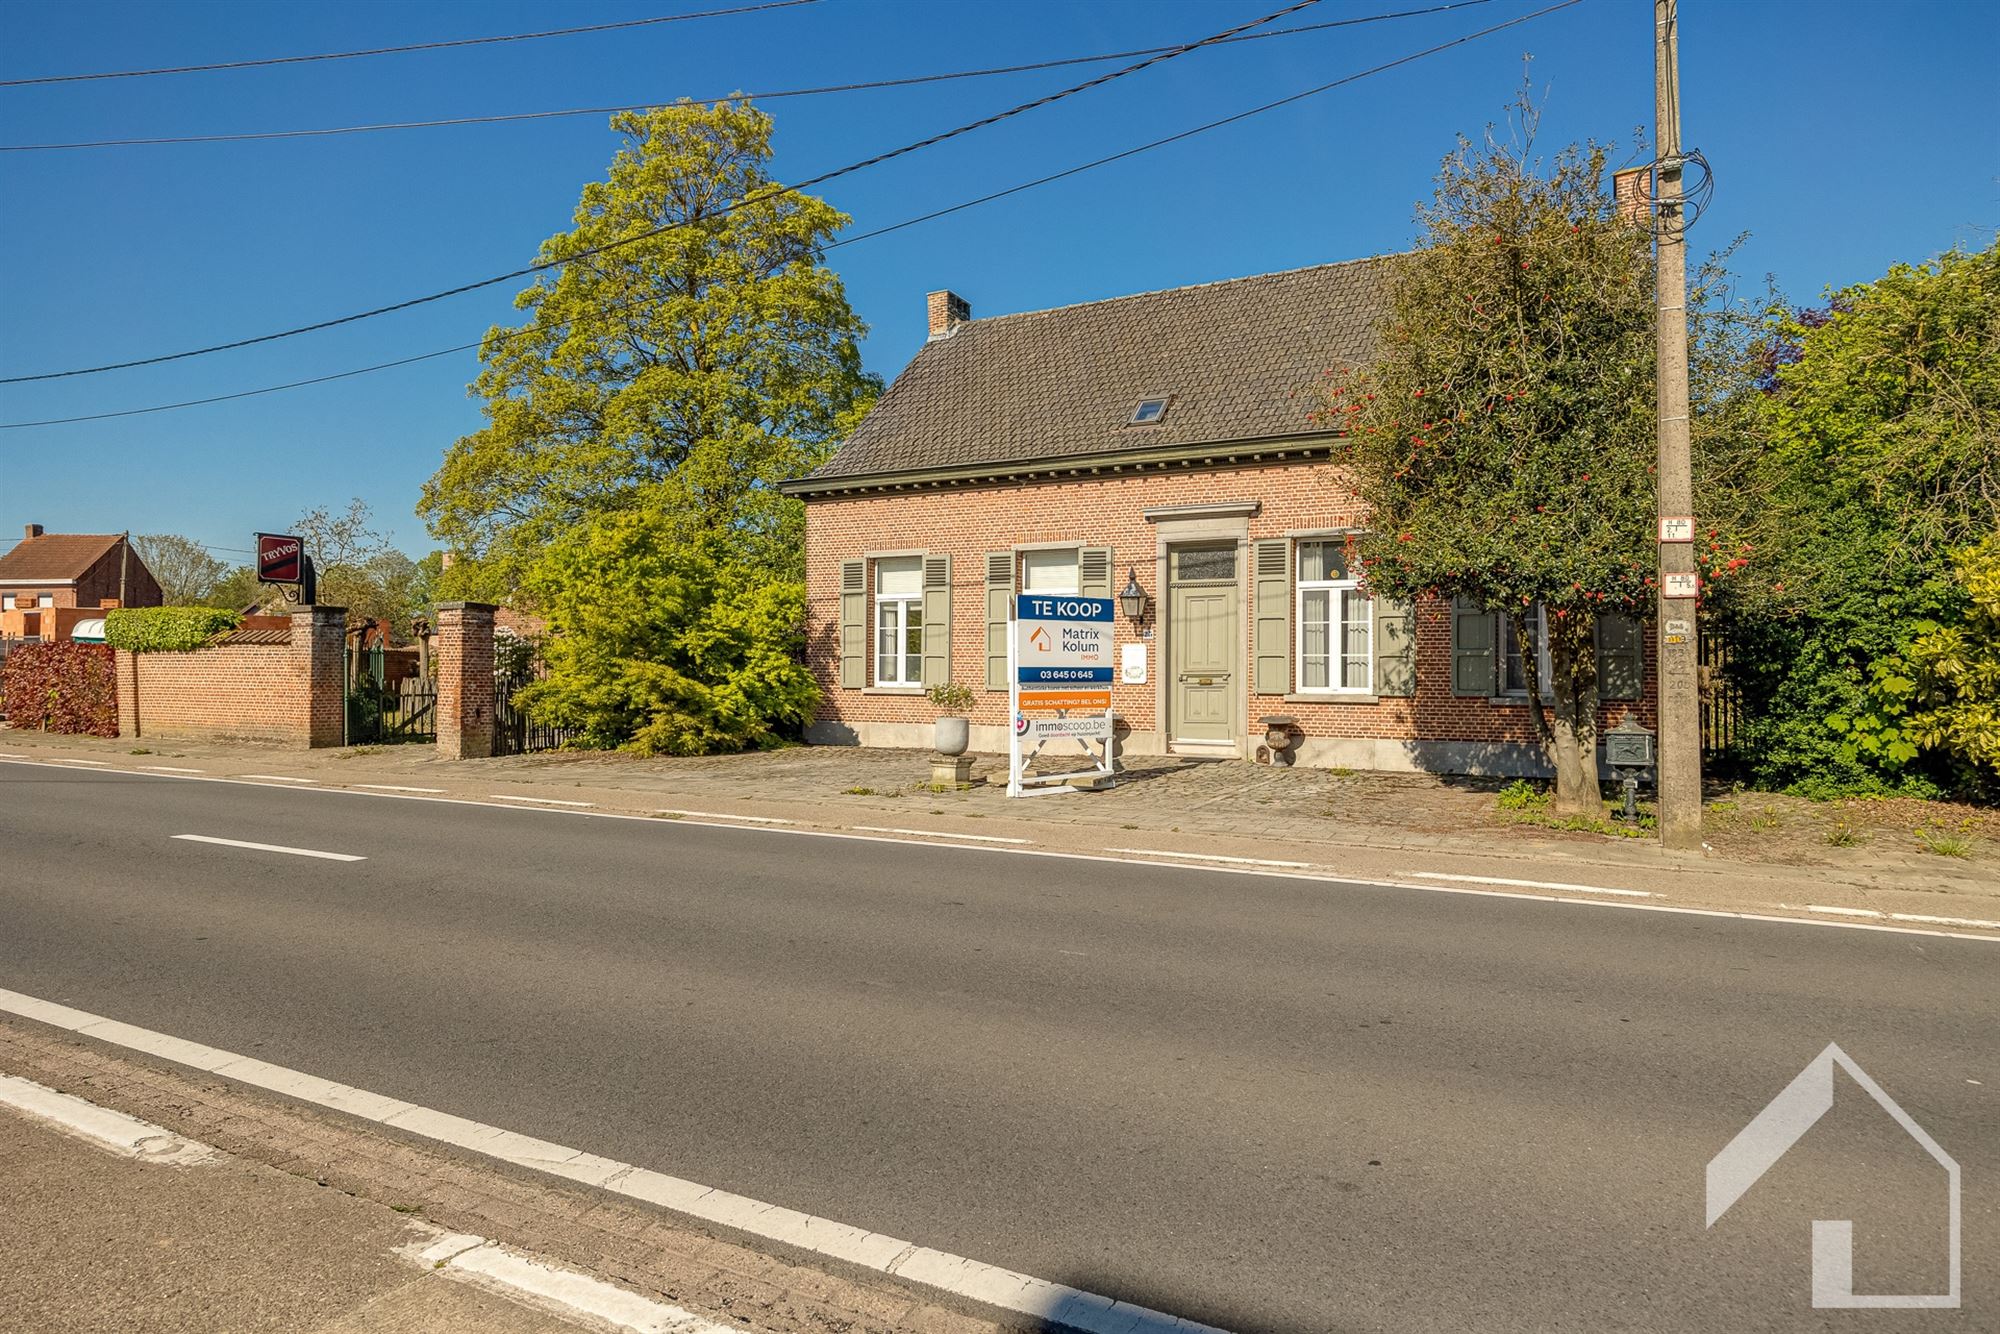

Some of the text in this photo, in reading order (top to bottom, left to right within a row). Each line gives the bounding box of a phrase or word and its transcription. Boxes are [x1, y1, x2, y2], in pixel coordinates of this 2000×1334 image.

[261, 543, 298, 561] TRYVOS
[1032, 600, 1102, 617] TE KOOP
[1062, 628, 1099, 640] Matrix
[1062, 640, 1099, 652] Kolum
[1040, 670, 1094, 679] 03 645 0 645
[1035, 720, 1106, 734] immoscoop.be
